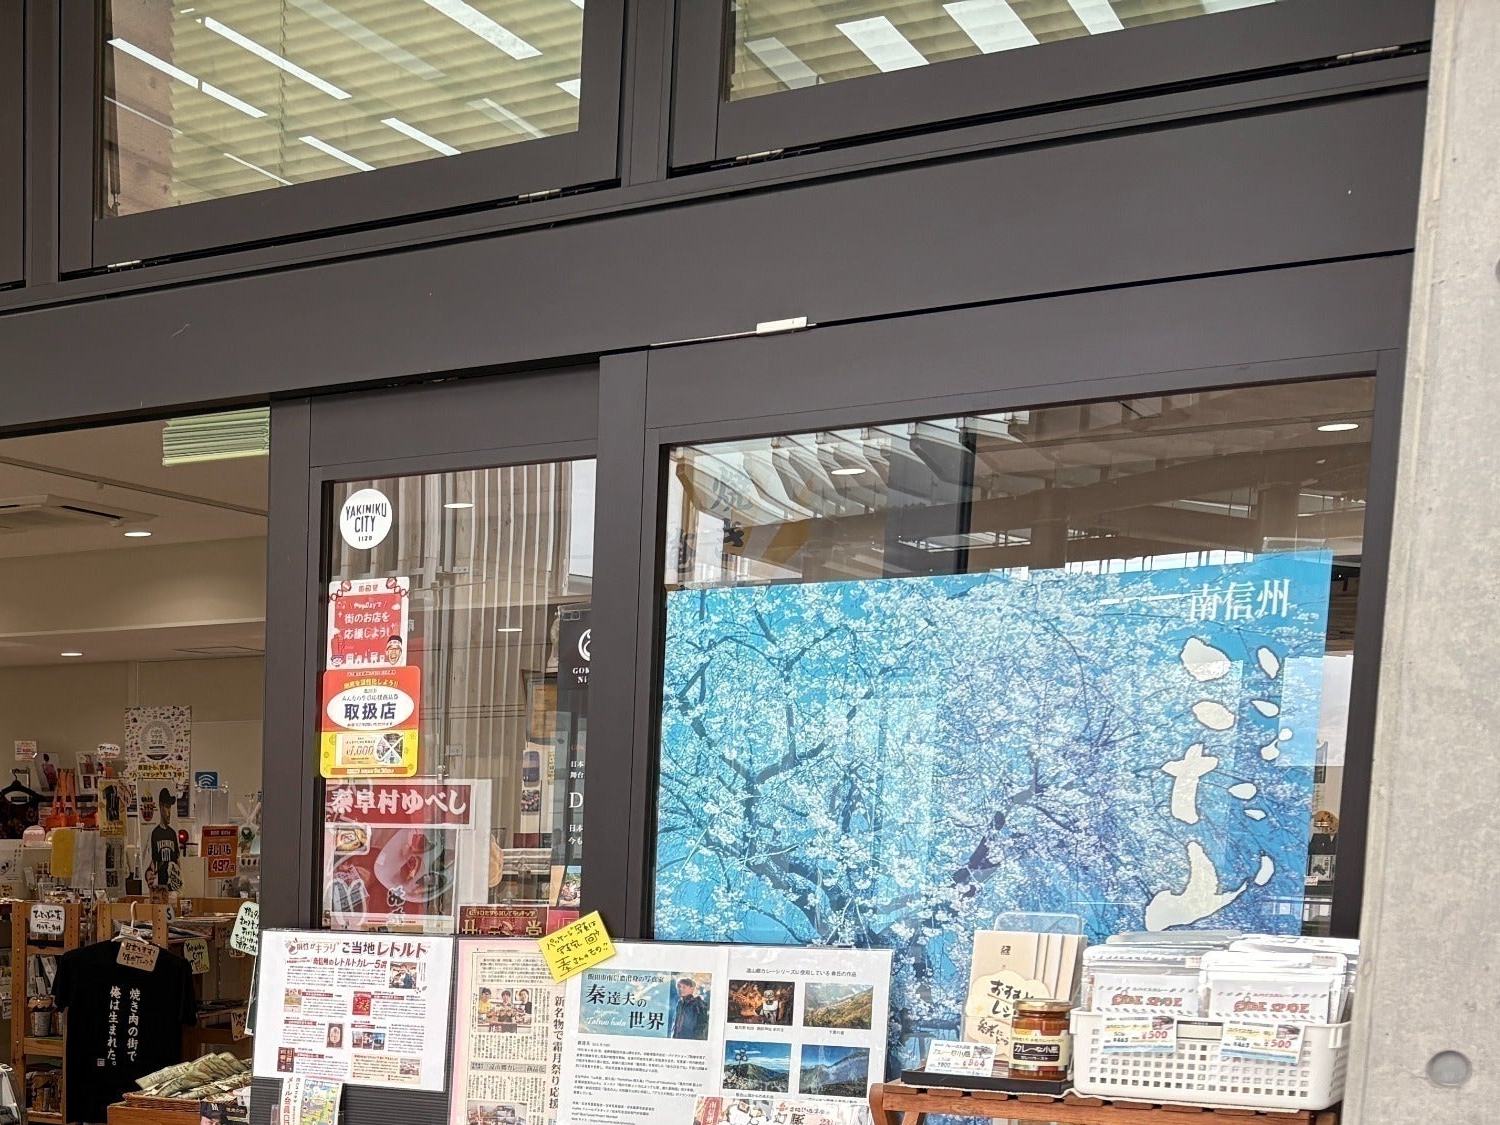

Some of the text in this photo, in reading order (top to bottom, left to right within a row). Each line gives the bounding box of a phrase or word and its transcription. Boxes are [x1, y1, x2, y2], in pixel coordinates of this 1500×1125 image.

[345, 502, 387, 520] YAKINIKU
[354, 516, 376, 533] CITY
[1189, 578, 1290, 623] 南信州
[344, 611, 390, 624] 街のお店を
[344, 627, 390, 640] 応援しよう!
[344, 702, 396, 720] 取扱店
[342, 941, 428, 958] ご当地レトルト
[587, 984, 647, 1008] 秦達夫の
[107, 986, 121, 1066] 俺は生まれた。
[127, 988, 141, 1062] 焼き肉の街で
[629, 1011, 665, 1030] 世界
